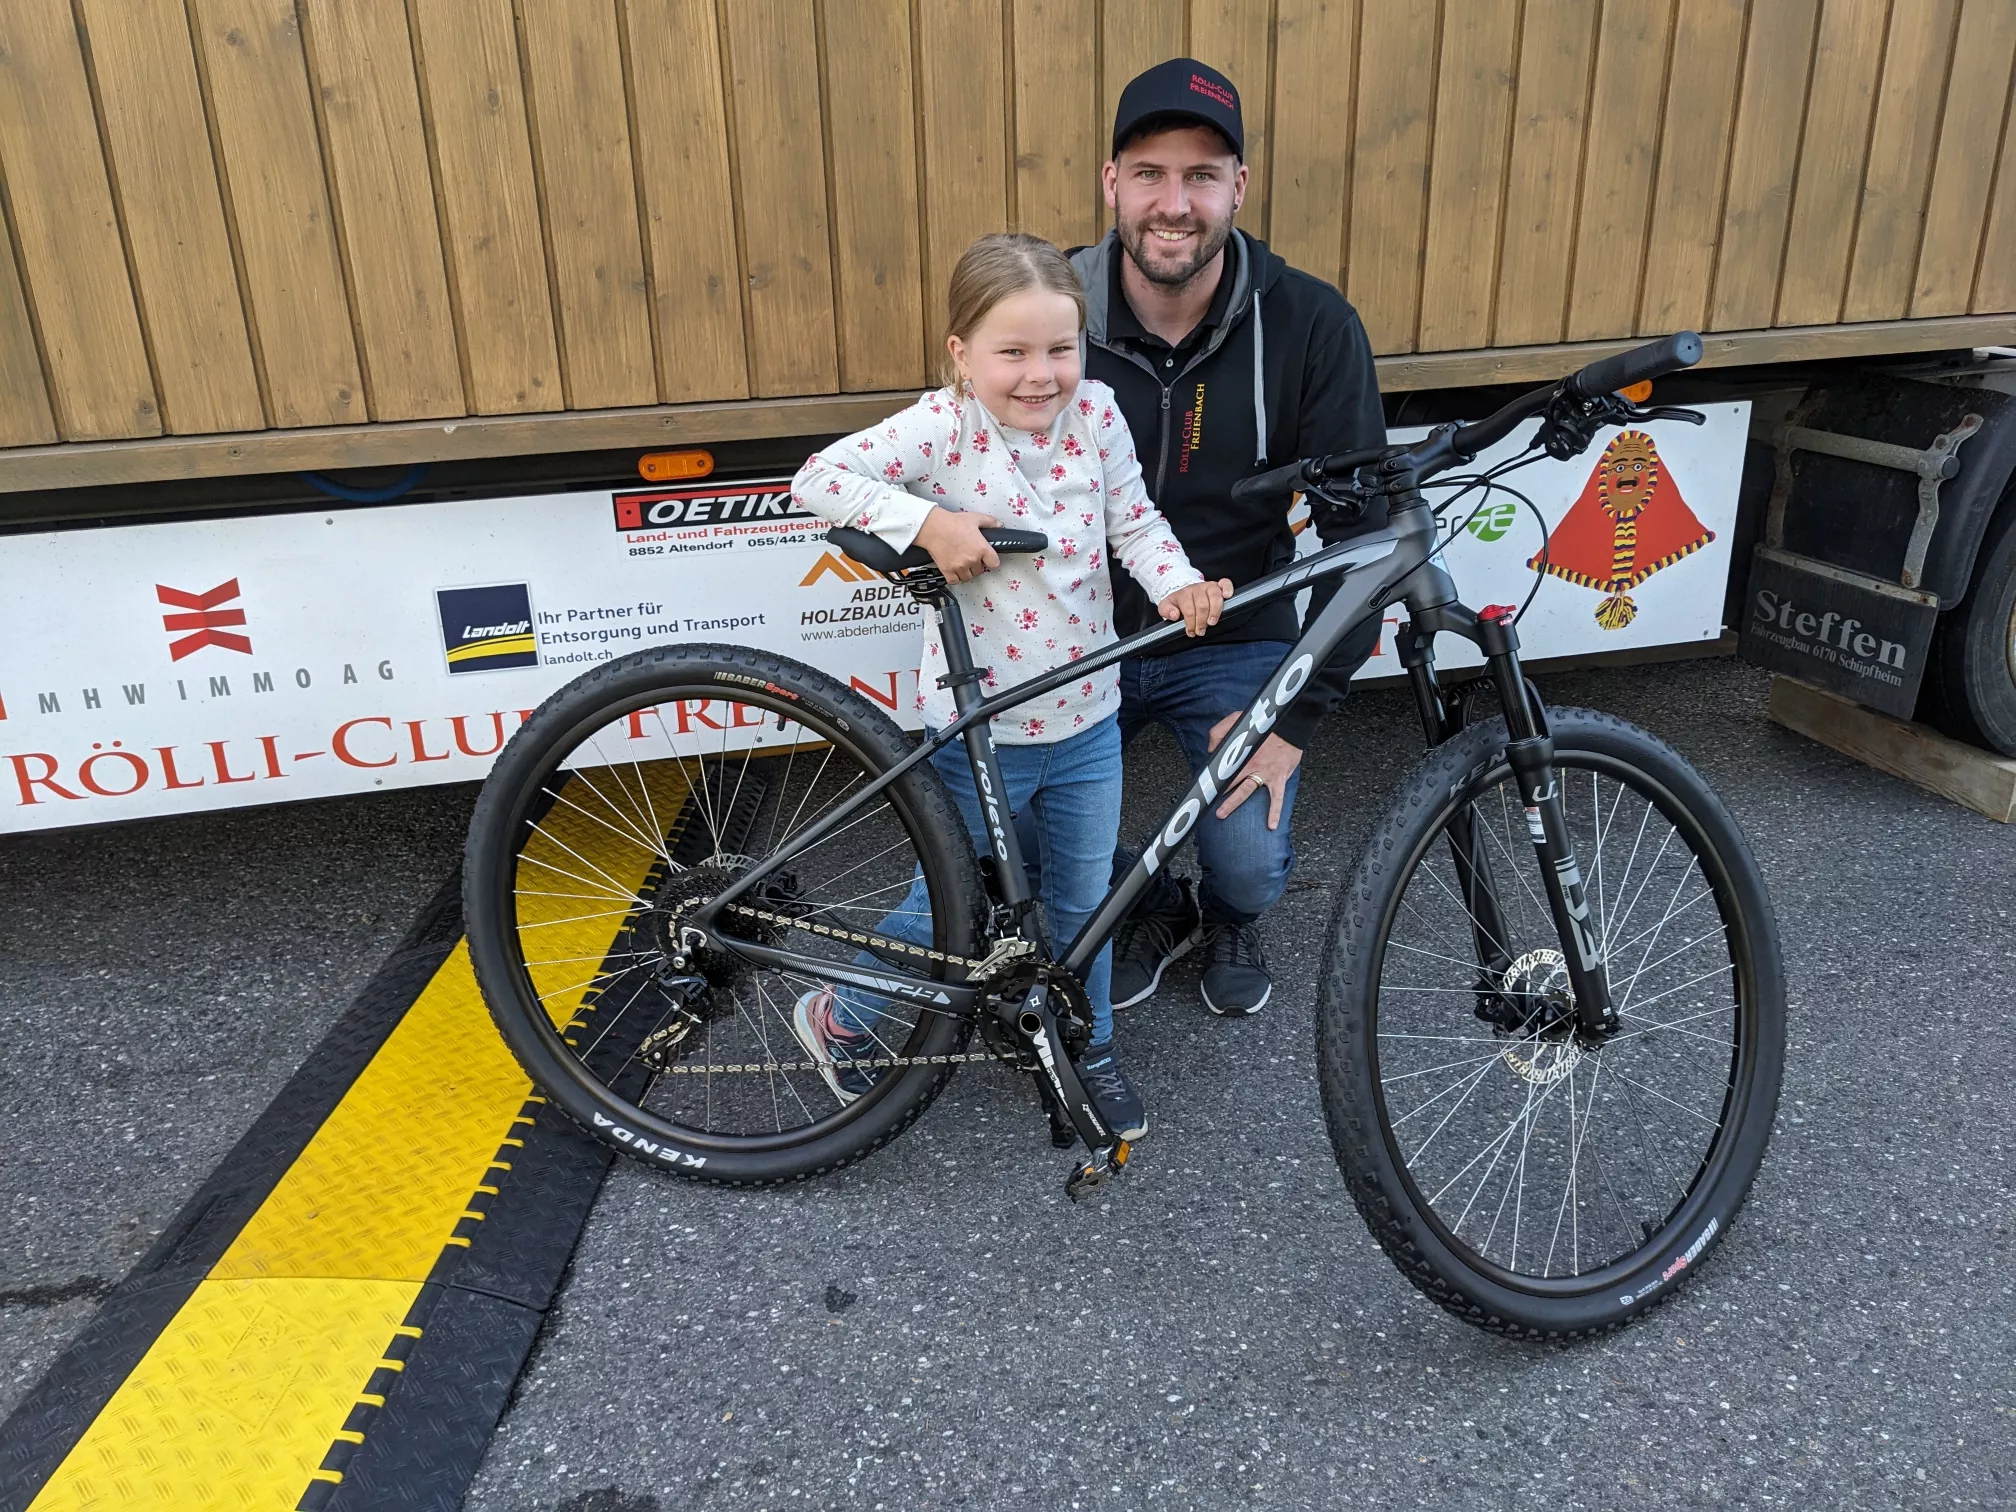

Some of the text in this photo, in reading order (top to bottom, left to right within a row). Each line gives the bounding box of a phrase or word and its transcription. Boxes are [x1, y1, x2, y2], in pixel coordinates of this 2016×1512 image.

[1190, 383, 1205, 450] FREIENBACH
[626, 519, 834, 544] Land- und Fahrzeugtechn
[629, 545, 664, 557] 8852
[668, 540, 734, 553] Altendorf
[748, 535, 806, 548] 055/442
[461, 620, 532, 640] Landolt
[537, 602, 664, 626] Ihr Partner für
[541, 612, 766, 646] Entsorgung und Transport
[800, 604, 891, 626] HOLZBAU
[893, 601, 920, 617] AG
[800, 618, 925, 642] www.abderhalden-
[1753, 589, 1907, 671] Steffen
[544, 648, 613, 666] landolt.ch
[1750, 620, 1903, 688] Fahrzeugbau 6170 Schüpfheim
[1142, 653, 1314, 877] roleto
[1448, 748, 1508, 800] KEN
[976, 760, 1008, 861] roleto
[593, 1111, 708, 1169] KENDA
